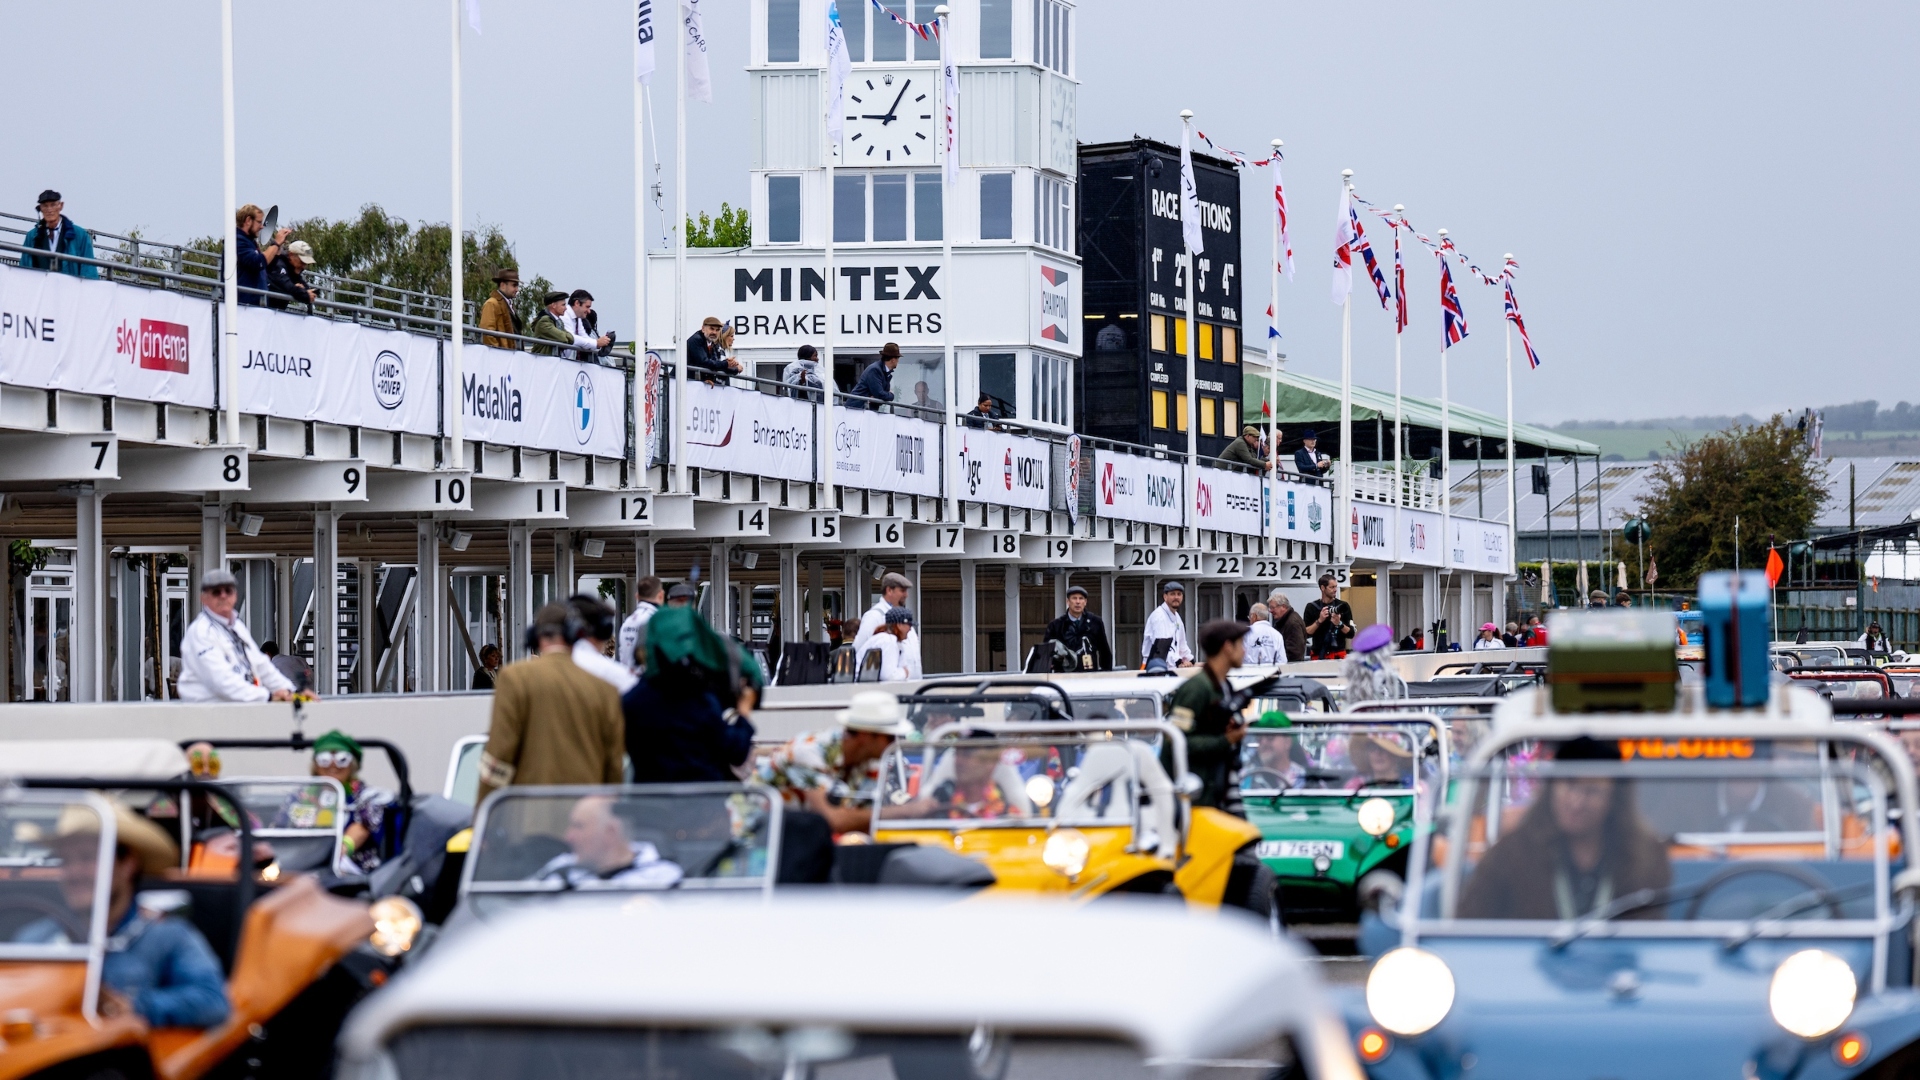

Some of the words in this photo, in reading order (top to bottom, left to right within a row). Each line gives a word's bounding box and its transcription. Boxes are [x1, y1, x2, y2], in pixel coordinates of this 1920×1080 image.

[1152, 188, 1178, 221] RACE
[1180, 195, 1232, 233] ITIONS
[734, 265, 942, 302] MINTEX
[734, 314, 825, 336] BRAKE
[841, 312, 942, 334] LINERS
[117, 318, 139, 364] sky
[142, 325, 187, 363] cinema
[242, 349, 312, 378] JAGUAR
[379, 363, 396, 379] LAND
[380, 380, 401, 396] ROVER
[461, 371, 522, 423] Medallia
[90, 441, 110, 471] 7
[222, 454, 241, 483] 8
[1017, 456, 1045, 490] MOTUL
[343, 467, 361, 494] 9
[434, 478, 465, 504] 10
[536, 488, 560, 513] 11
[620, 497, 648, 520] 12
[738, 508, 764, 531] 14
[811, 517, 836, 538] 15
[1362, 515, 1385, 547] MOTUL
[875, 523, 900, 544] 16
[935, 528, 960, 548] 17
[992, 534, 1016, 554] 18
[1046, 539, 1069, 559] 19
[1132, 548, 1156, 566] 20
[1178, 553, 1199, 570] 21
[1216, 557, 1239, 574] 22
[1256, 561, 1278, 577] 23
[1290, 565, 1312, 580] 24
